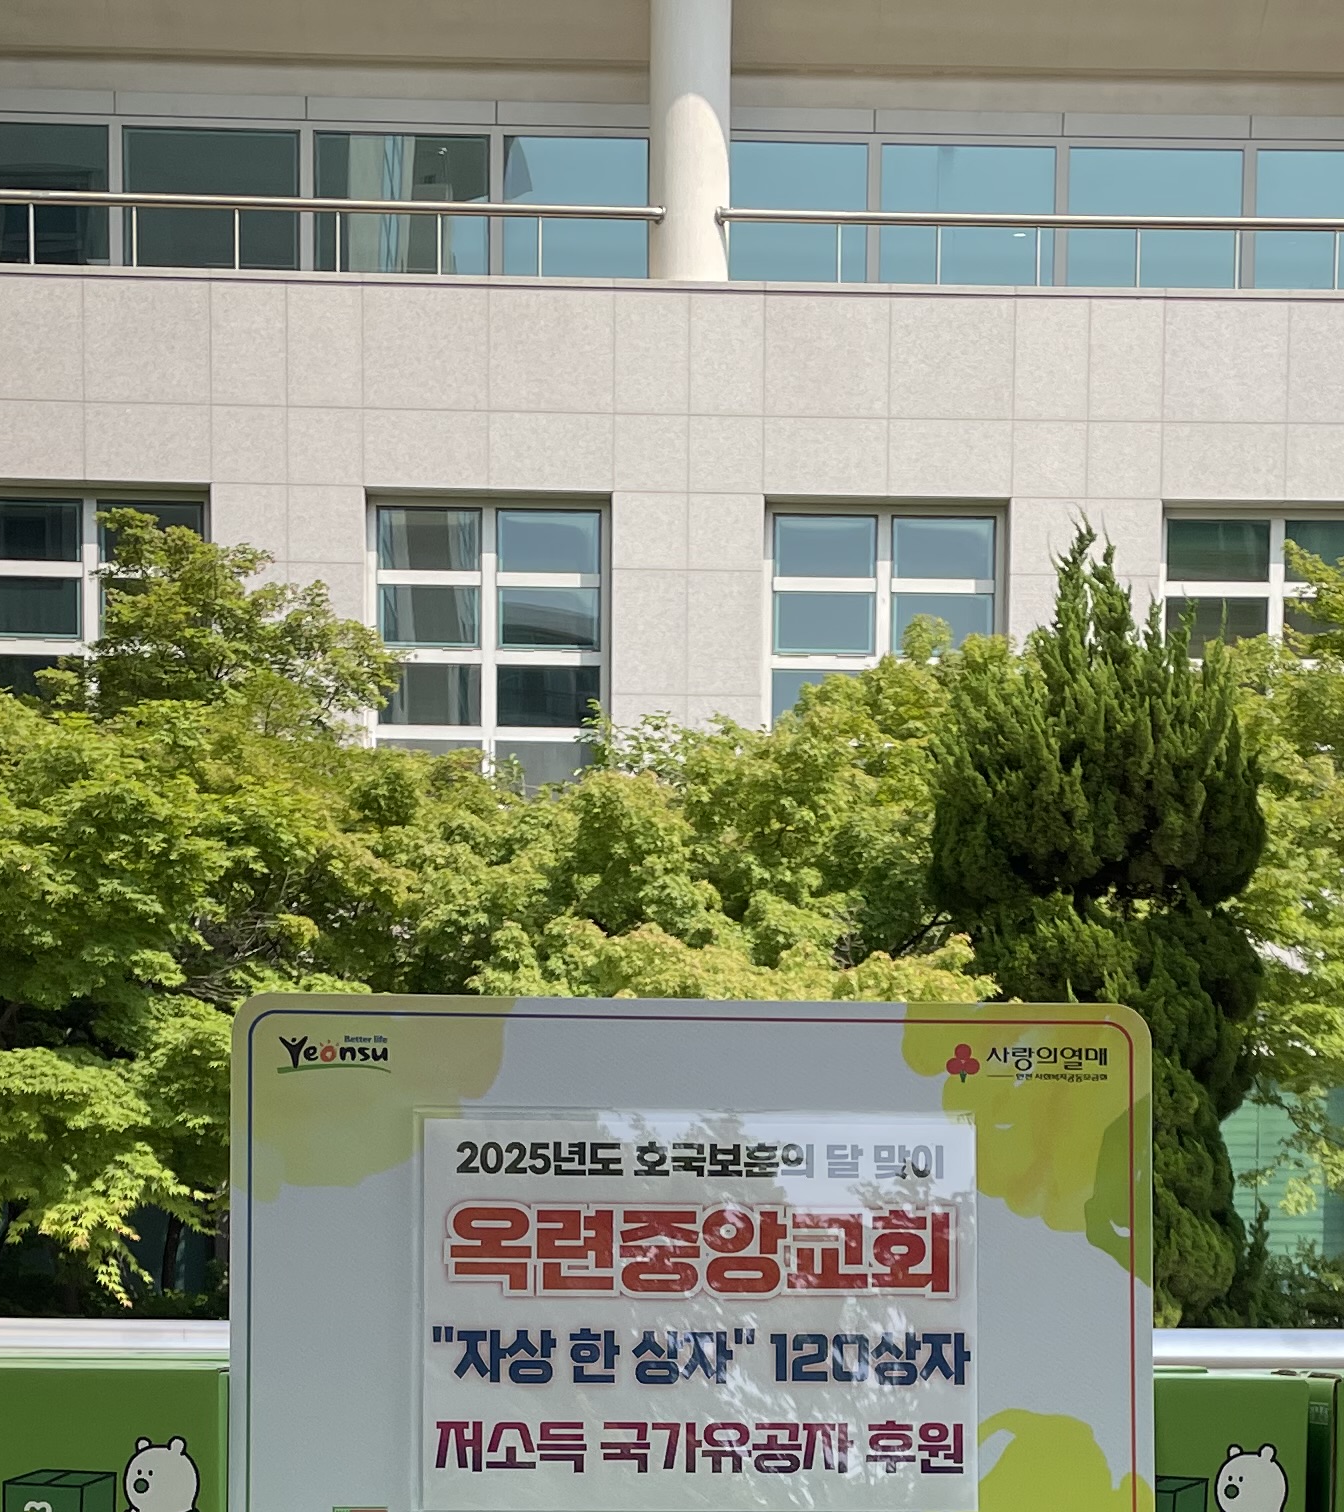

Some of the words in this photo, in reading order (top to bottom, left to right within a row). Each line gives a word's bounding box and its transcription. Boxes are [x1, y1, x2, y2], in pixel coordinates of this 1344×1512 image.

[278, 1036, 388, 1069] Yeonsu
[986, 1047, 1108, 1071] 사랑의열매
[456, 1141, 625, 1178] 2025년도
[634, 1141, 815, 1179] 호국보훈의
[826, 1143, 864, 1179] 달
[873, 1143, 945, 1179] 맞이
[448, 1203, 952, 1297] 옥련중앙교회
[432, 1325, 556, 1383] "자상
[569, 1327, 620, 1383] 한
[634, 1325, 755, 1384] 상자"
[770, 1332, 971, 1385] 120상자
[435, 1420, 587, 1473] 저소득
[600, 1420, 853, 1474] 국가유공자
[865, 1420, 964, 1475] 후원
